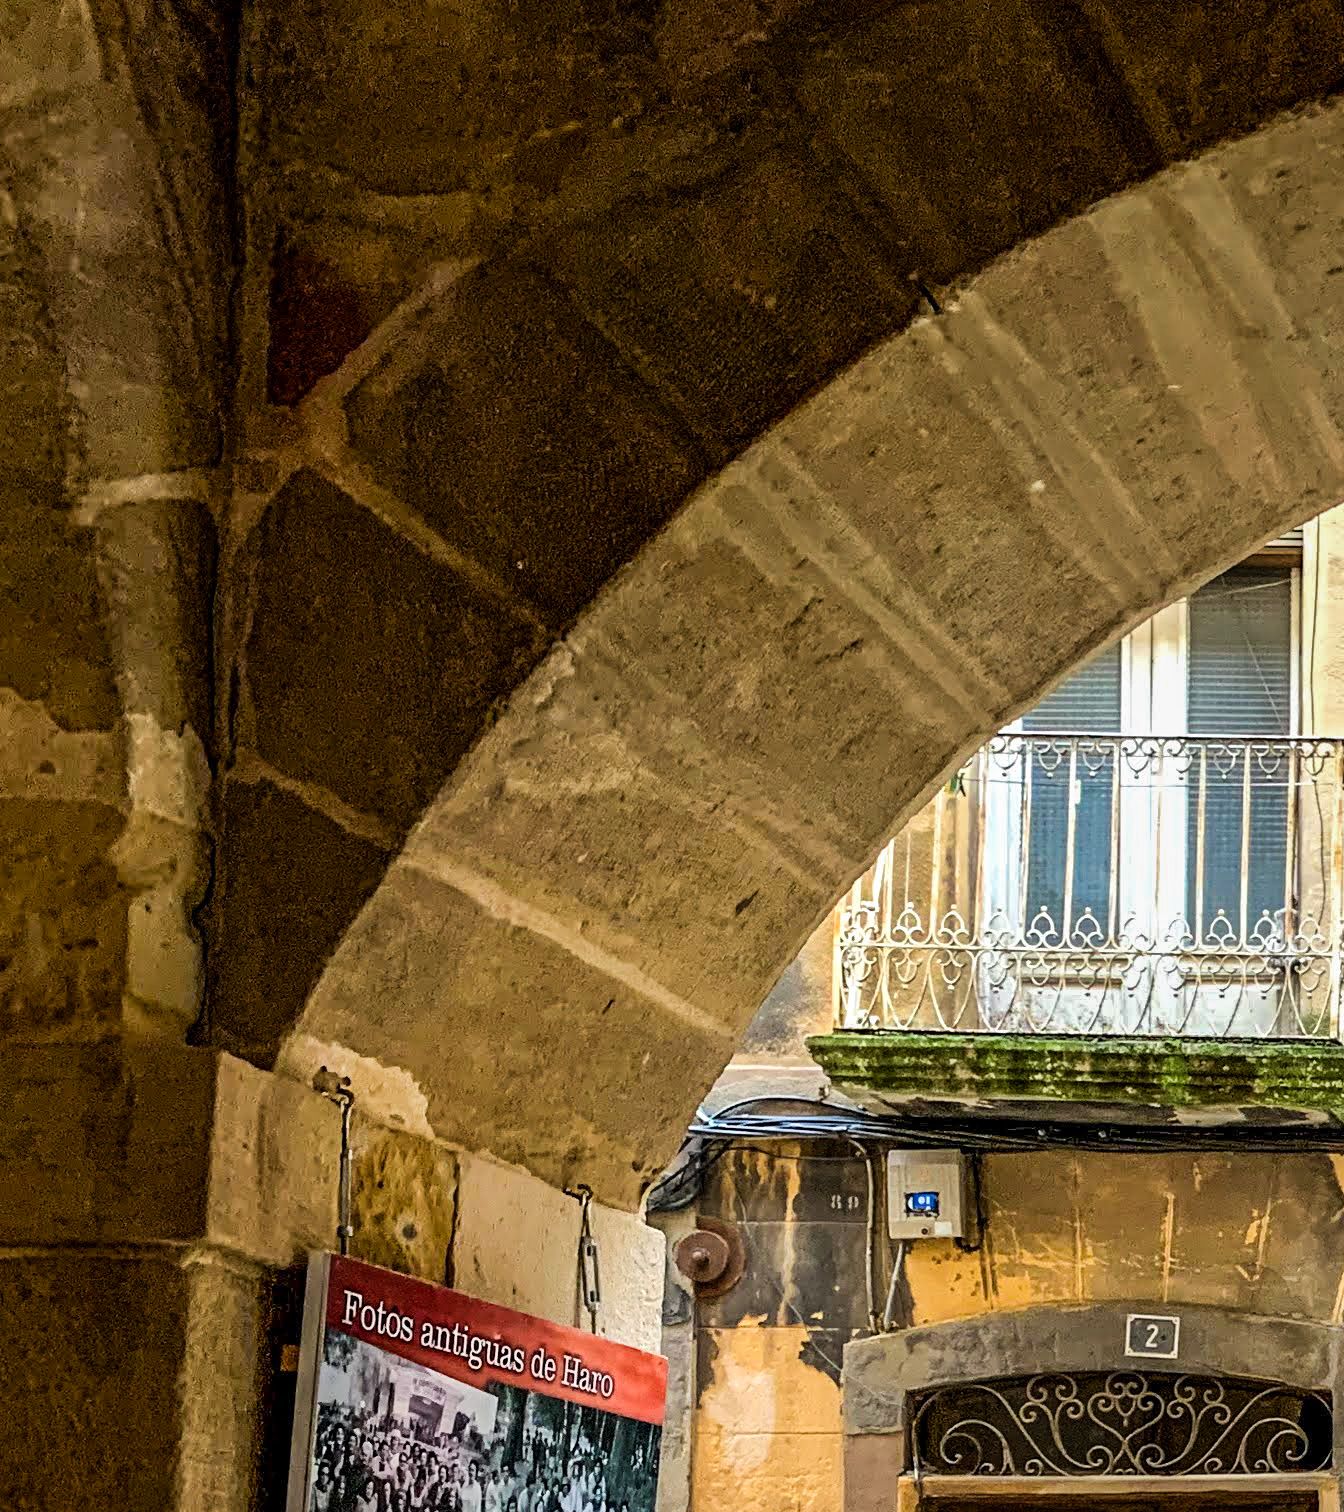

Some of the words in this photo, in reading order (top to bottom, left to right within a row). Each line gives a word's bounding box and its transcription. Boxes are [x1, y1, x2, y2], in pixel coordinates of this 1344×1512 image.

[341, 1289, 414, 1343] Fotos
[420, 1322, 525, 1371] antiguas
[530, 1347, 557, 1382] de
[561, 1353, 614, 1398] Haro
[1145, 1323, 1159, 1348] 2
